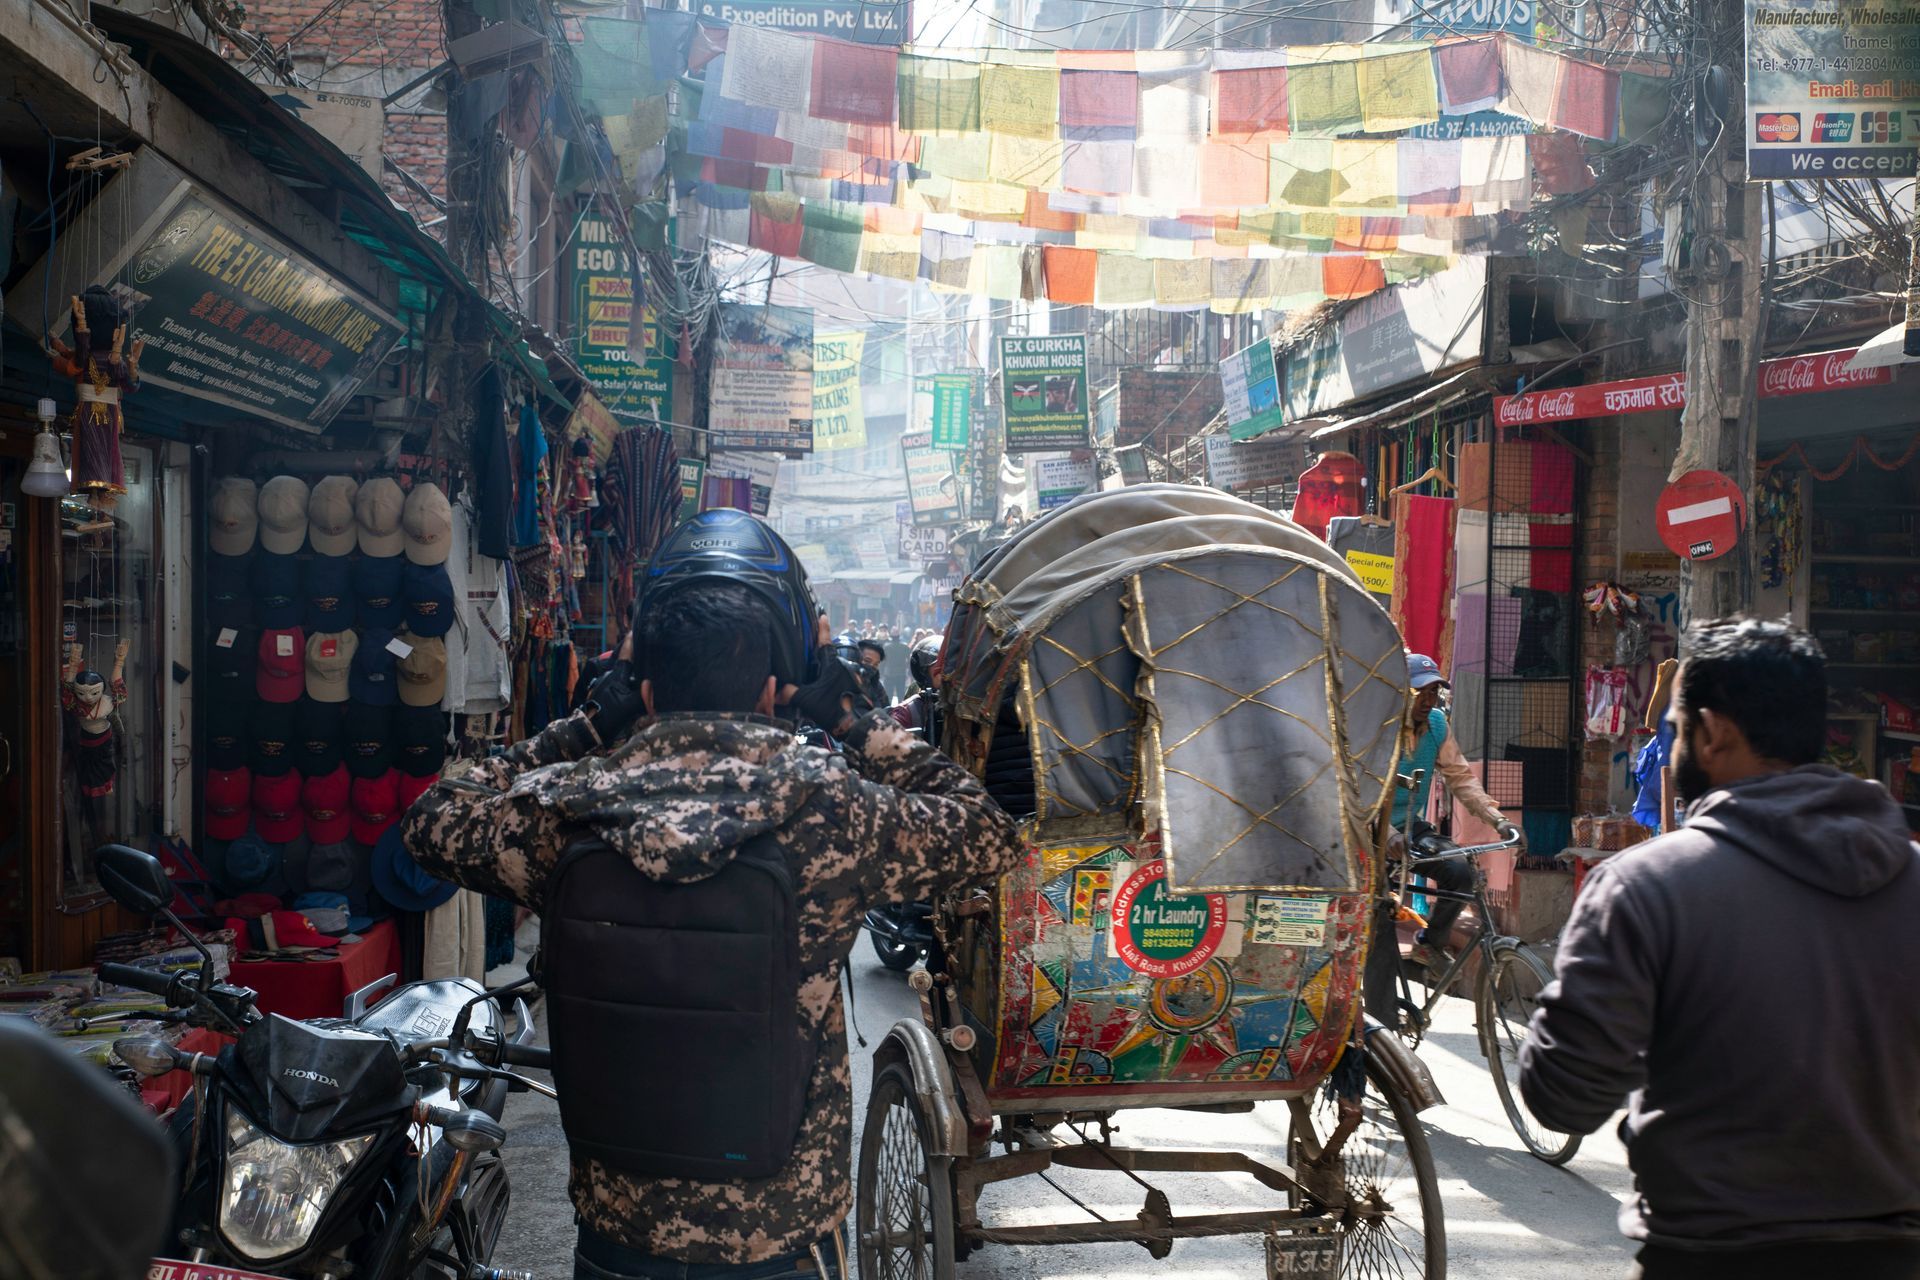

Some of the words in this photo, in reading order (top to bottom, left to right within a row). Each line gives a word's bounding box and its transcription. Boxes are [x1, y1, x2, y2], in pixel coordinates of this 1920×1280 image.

[721, 5, 817, 29] Expedition
[864, 10, 898, 30] Ltd.
[1754, 9, 1845, 28] Manufacturer,
[1844, 35, 1896, 50] Thamel,
[1757, 58, 1779, 71] Tel:
[1783, 58, 1888, 71] +977-1-4412804
[1809, 80, 1859, 98] Email:
[1759, 122, 1799, 133] MasterCard
[1814, 119, 1851, 131] UnionPay
[1861, 122, 1901, 134] JCB
[1791, 152, 1825, 170] We
[1832, 152, 1914, 174] accept
[577, 248, 616, 272] ECO
[190, 224, 243, 277] THE
[220, 241, 263, 287] EX
[243, 253, 307, 315] GURKHA
[332, 307, 381, 354] HOUSE
[130, 327, 165, 348] E-mail:
[160, 317, 197, 342] Thamel,
[815, 342, 848, 362] IRST
[1005, 340, 1022, 353] EX
[1026, 338, 1083, 352] GURKHA
[167, 360, 204, 381] Website:
[1005, 355, 1049, 369] KHUKURI
[1051, 354, 1084, 367] HOUSE
[1604, 386, 1656, 412] चक्रमान
[902, 436, 931, 447] MOB
[987, 429, 997, 457] BAG
[1209, 438, 1234, 450] Enco
[973, 422, 985, 507] HIMALAYAN
[986, 464, 996, 500] SHOP
[690, 538, 738, 550] YOHE
[909, 528, 935, 540] SIM
[903, 541, 944, 553] CARD
[1347, 556, 1374, 567] Special
[1375, 561, 1394, 570] offer
[1361, 576, 1390, 588] 1500/-
[1115, 864, 1164, 927] Address-To
[1212, 896, 1224, 928] Park
[1132, 904, 1141, 925] 2
[1143, 904, 1157, 925] hr
[1158, 904, 1207, 929] Laundry
[1121, 943, 1138, 964] Link
[1138, 958, 1168, 974] Road,
[1172, 944, 1212, 972] Khusibu
[283, 1068, 340, 1088] HONDA
[725, 1152, 749, 1161] DELL
